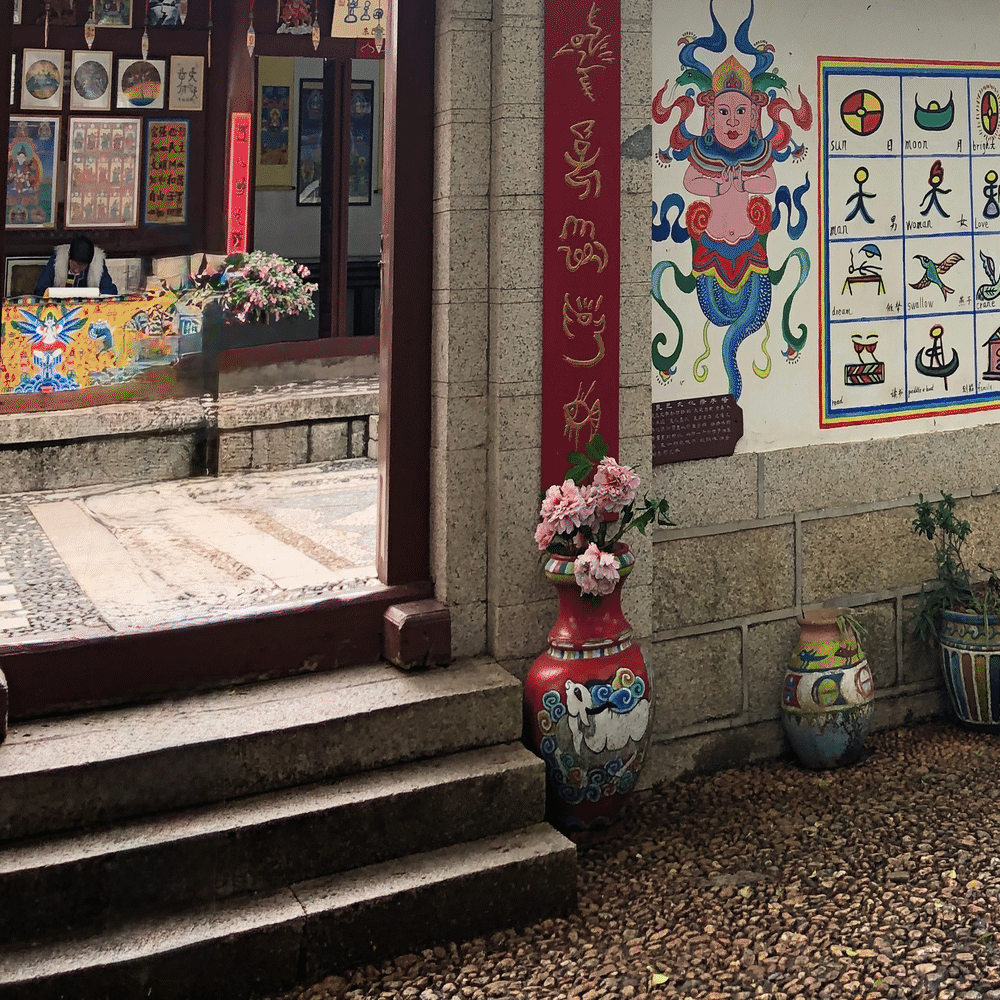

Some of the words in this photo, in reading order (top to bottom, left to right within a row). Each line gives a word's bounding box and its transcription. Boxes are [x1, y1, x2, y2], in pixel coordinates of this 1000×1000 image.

[830, 139, 847, 151] sun
[886, 139, 893, 151] 日
[905, 139, 928, 150] moon
[956, 139, 962, 152] 月
[890, 215, 897, 231] 男
[957, 214, 968, 227] 女
[830, 225, 848, 236] man
[907, 296, 934, 311] swallow
